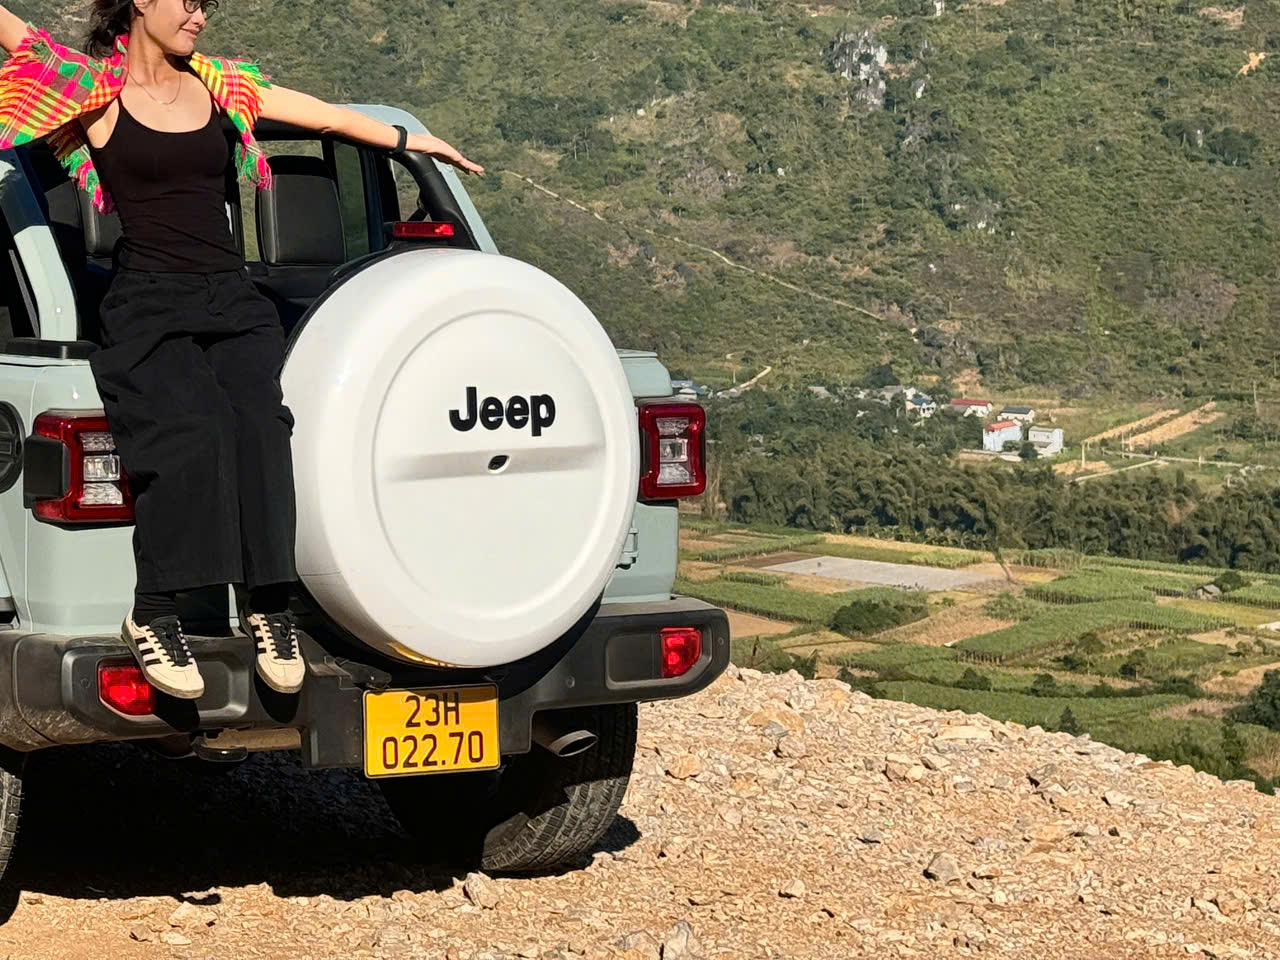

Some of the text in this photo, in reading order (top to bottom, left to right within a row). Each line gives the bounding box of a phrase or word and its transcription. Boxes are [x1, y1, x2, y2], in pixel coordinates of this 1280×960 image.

[449, 386, 556, 437] Jeep
[405, 692, 460, 728] 23H
[382, 730, 484, 770] 022.70
